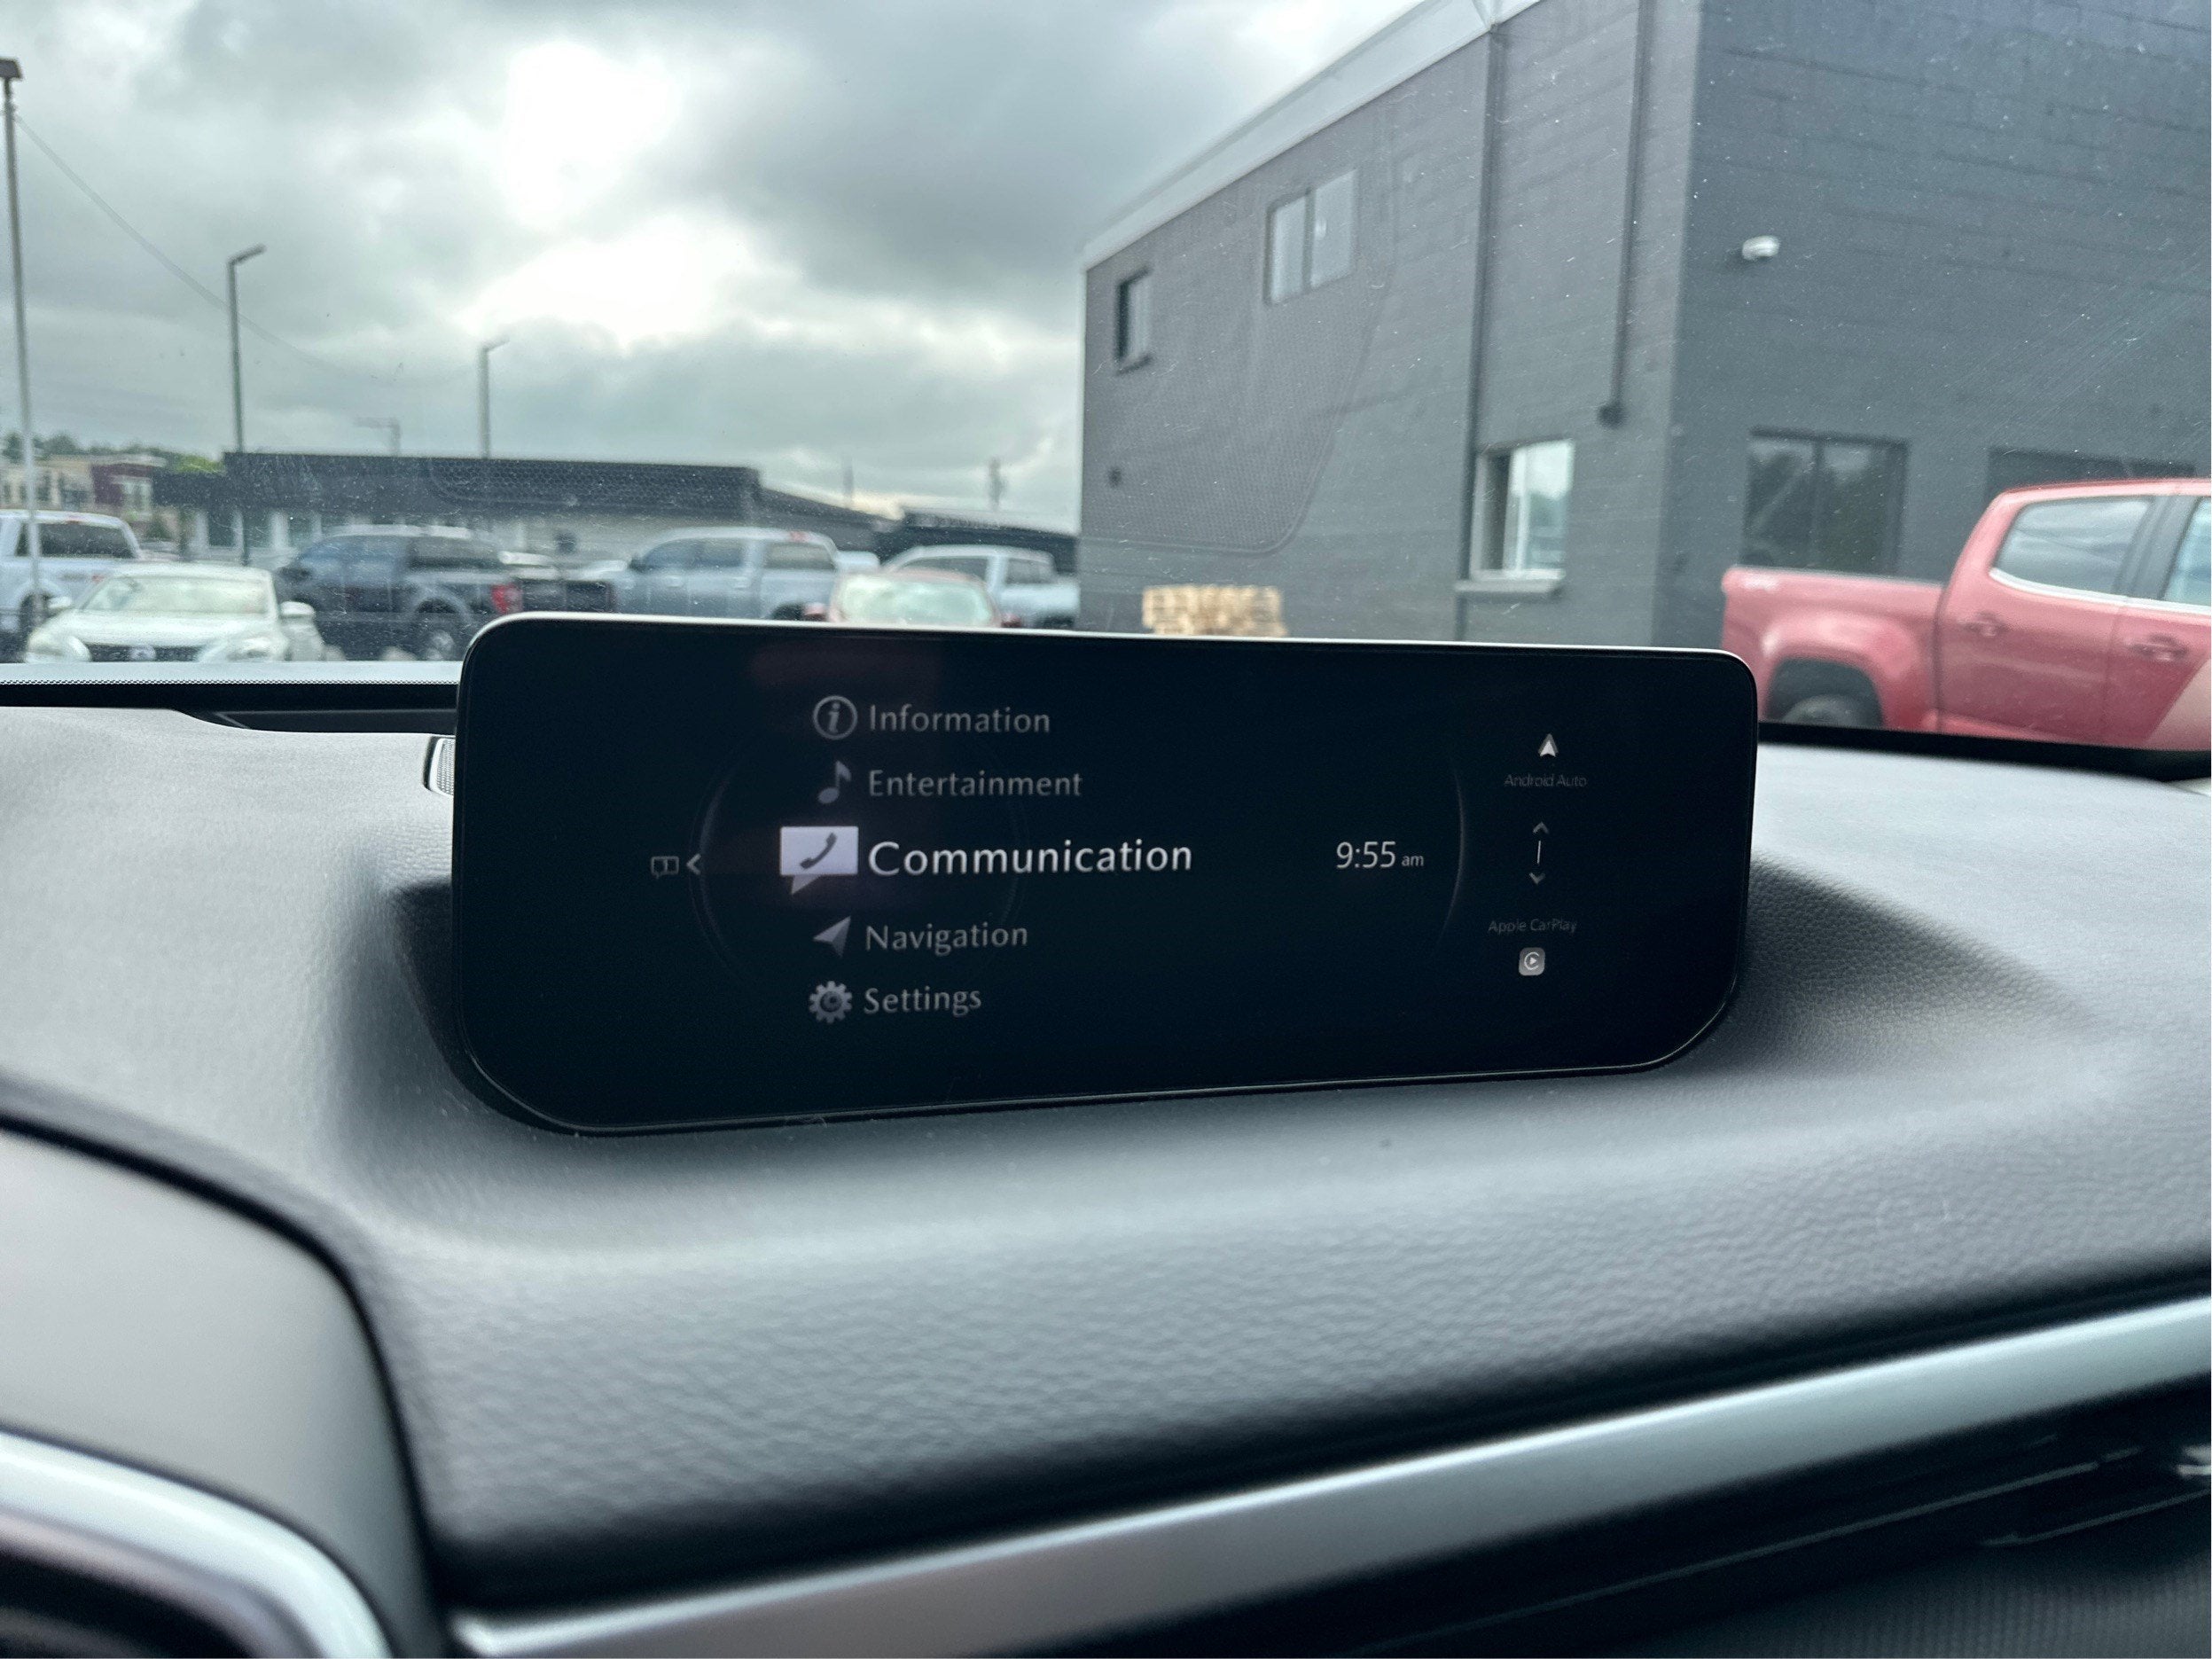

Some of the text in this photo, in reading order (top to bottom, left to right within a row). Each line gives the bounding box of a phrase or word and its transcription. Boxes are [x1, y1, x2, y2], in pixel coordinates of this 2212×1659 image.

[868, 704, 1051, 734] Information
[867, 769, 1083, 798] Entertainment
[1505, 774, 1587, 787] Android Auto
[868, 838, 1192, 877] Communication
[1336, 841, 1425, 869] 9:55 am
[865, 921, 1028, 957] Navigation
[1488, 917, 1577, 936] Apple CarPlay
[864, 986, 982, 1017] Settings
